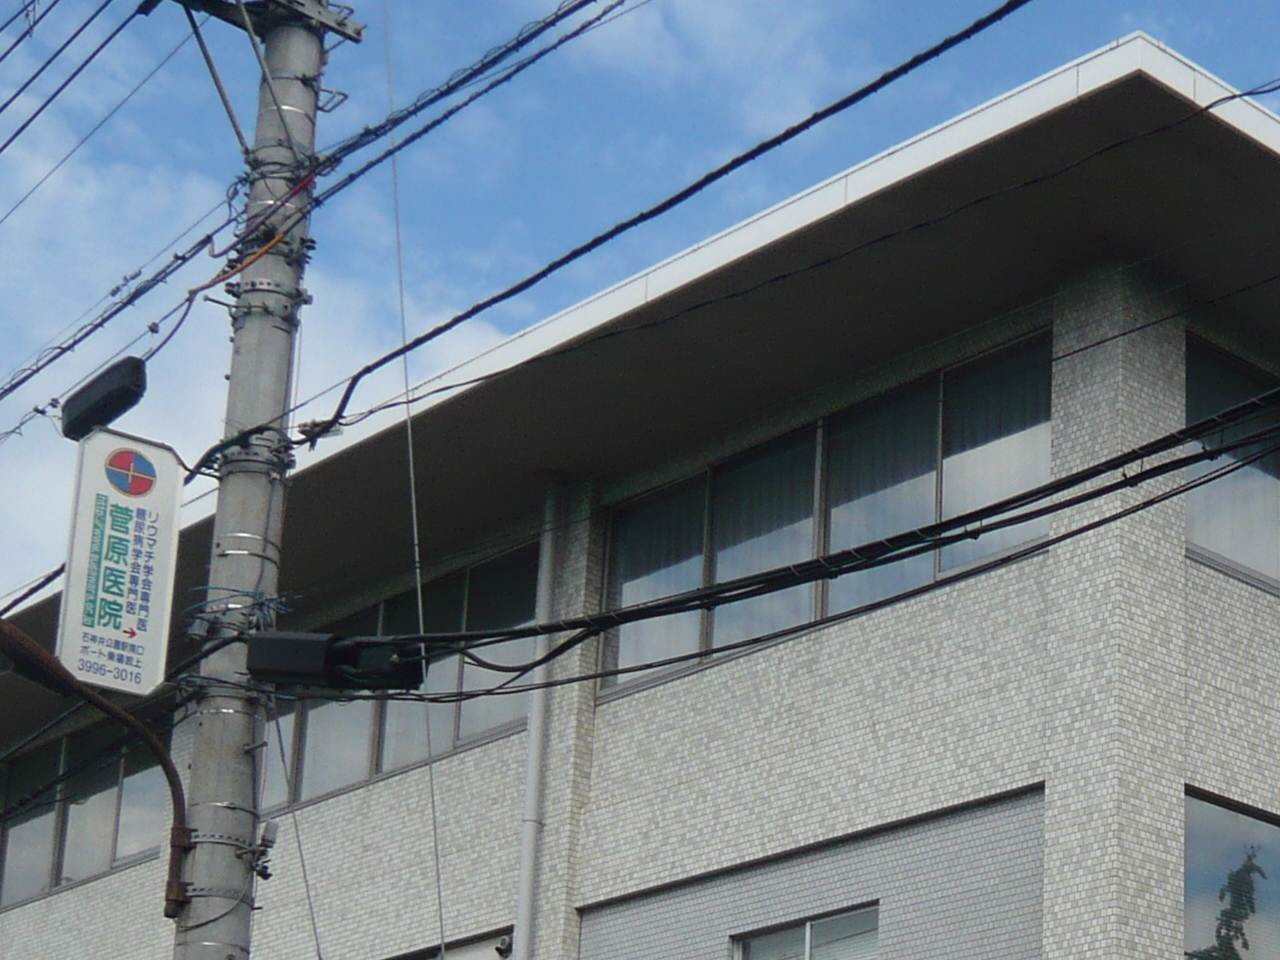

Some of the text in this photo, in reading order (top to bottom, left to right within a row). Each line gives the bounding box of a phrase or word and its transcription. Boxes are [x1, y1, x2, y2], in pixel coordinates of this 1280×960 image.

[98, 503, 134, 630] 菅原医院
[78, 658, 142, 685] 3996-3016
